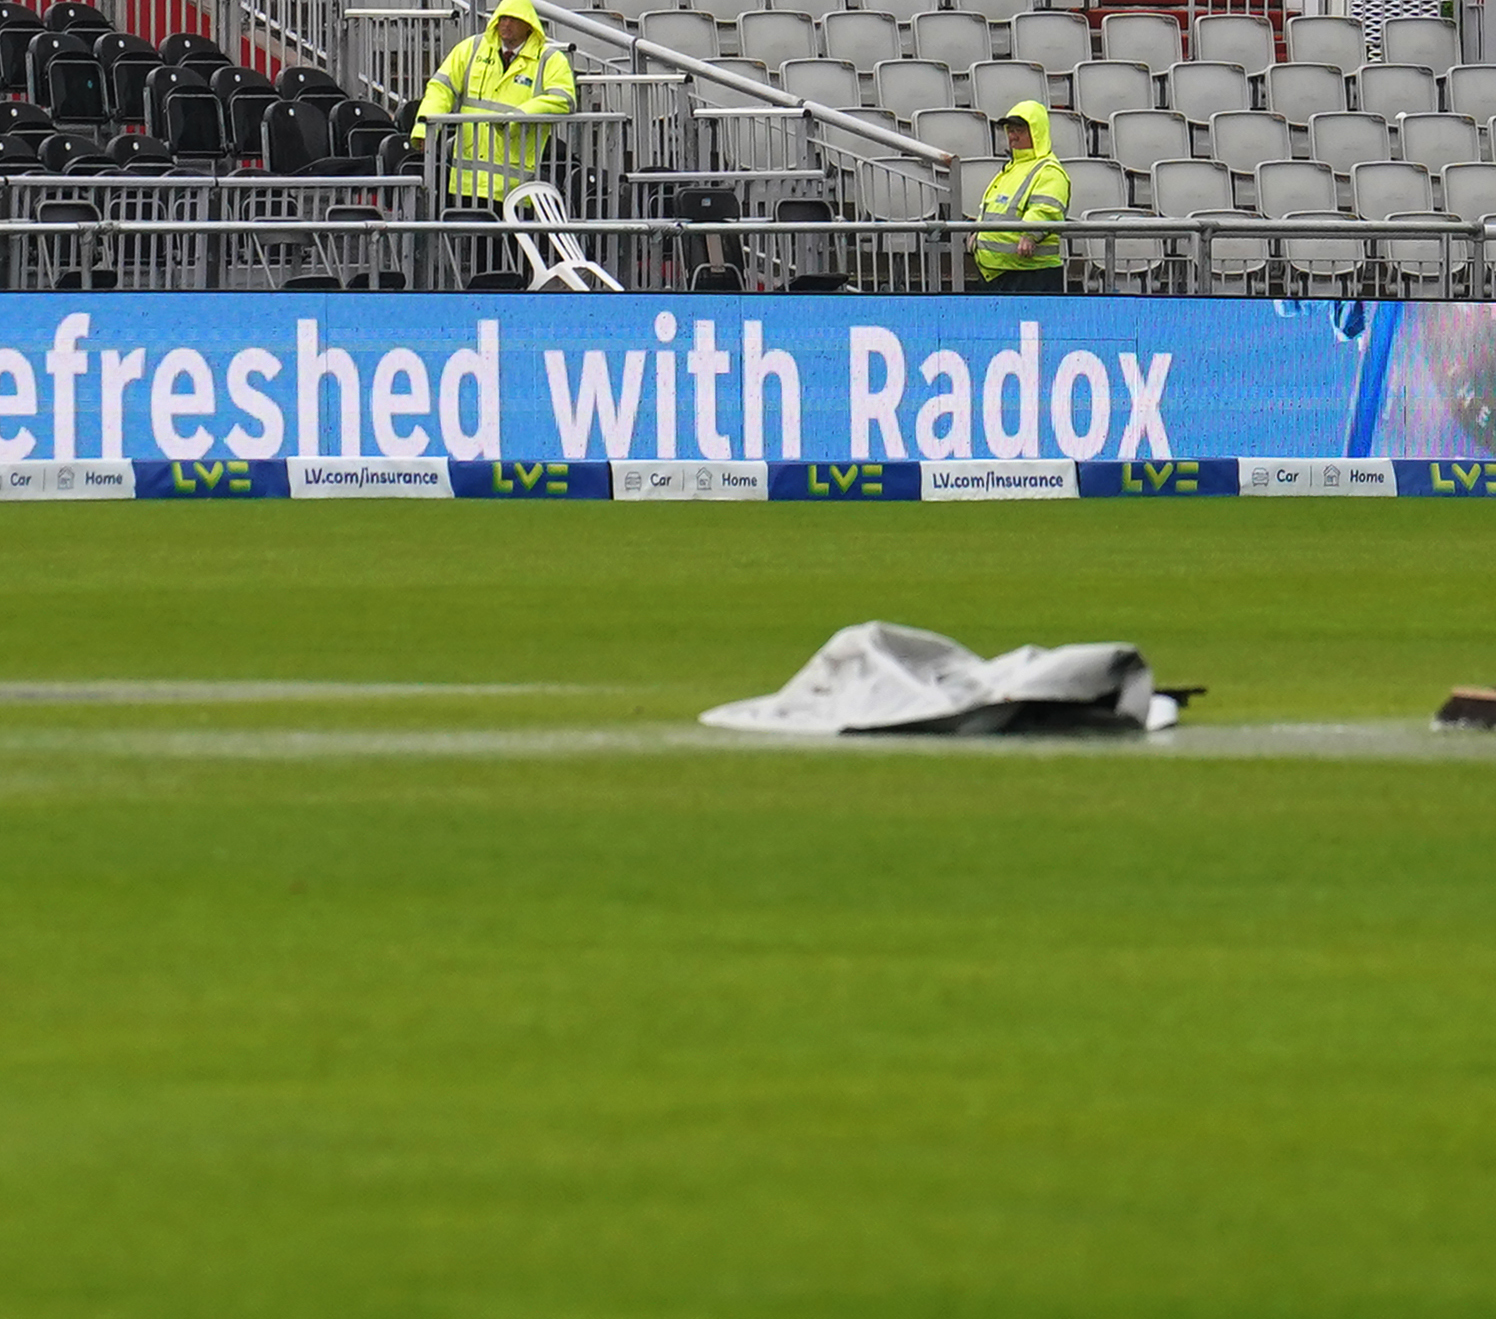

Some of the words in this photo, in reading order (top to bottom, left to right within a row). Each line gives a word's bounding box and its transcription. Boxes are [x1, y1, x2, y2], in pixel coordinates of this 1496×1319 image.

[544, 311, 801, 459] with
[850, 321, 1173, 460] Radox
[10, 472, 32, 487] Car
[85, 471, 123, 486] Home
[305, 468, 438, 488] LV.com/insurance
[650, 473, 672, 488] Car
[722, 473, 757, 488] Home
[933, 472, 1064, 492] LV.com/insurance
[1276, 469, 1299, 484] Car
[1350, 469, 1384, 484] Home
